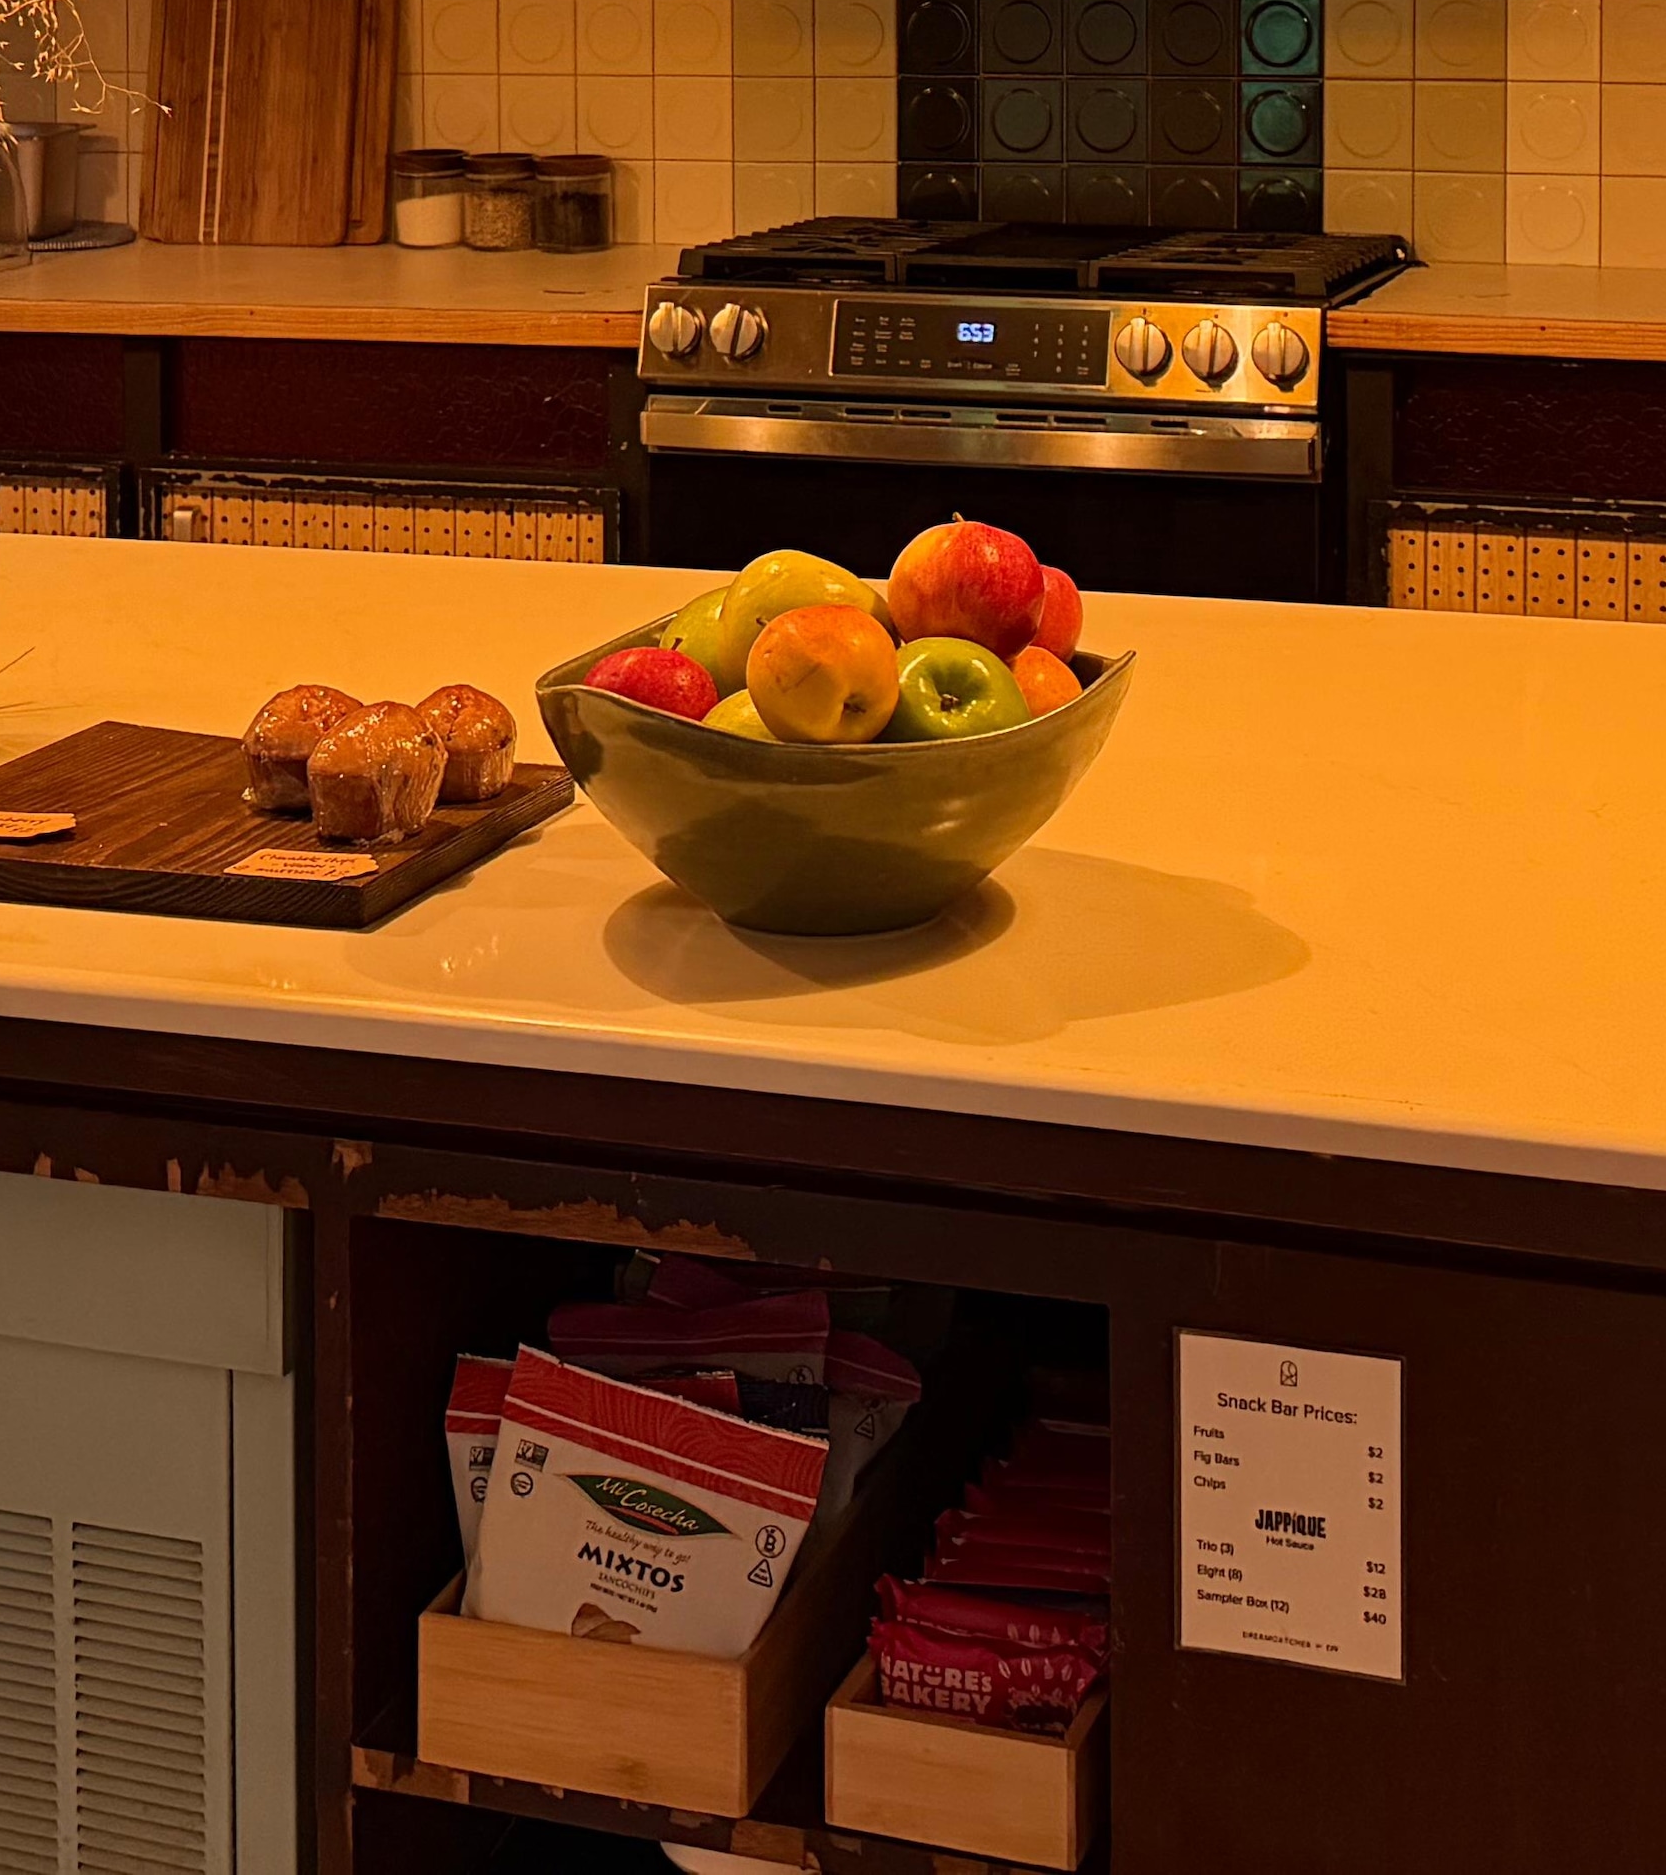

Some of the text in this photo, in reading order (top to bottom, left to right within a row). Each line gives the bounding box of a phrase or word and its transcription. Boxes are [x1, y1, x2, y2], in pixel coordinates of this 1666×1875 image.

[1217, 1392, 1358, 1425] Snack Bar Prices:
[1193, 1425, 1384, 1459] Fruits $2
[1193, 1450, 1384, 1484] Fig Bars $2
[596, 1478, 700, 1531] Mi Cosecha
[1193, 1475, 1384, 1510] Chips $2
[585, 1520, 605, 1536] The
[1266, 1535, 1315, 1551] Hot Sauce
[577, 1541, 685, 1593] MIXTOS
[1196, 1539, 1386, 1574] Trio (3) $12
[1197, 1564, 1225, 1579] Eight
[1363, 1585, 1387, 1600] $28
[1197, 1588, 1387, 1625] Sampler Box (12) $40
